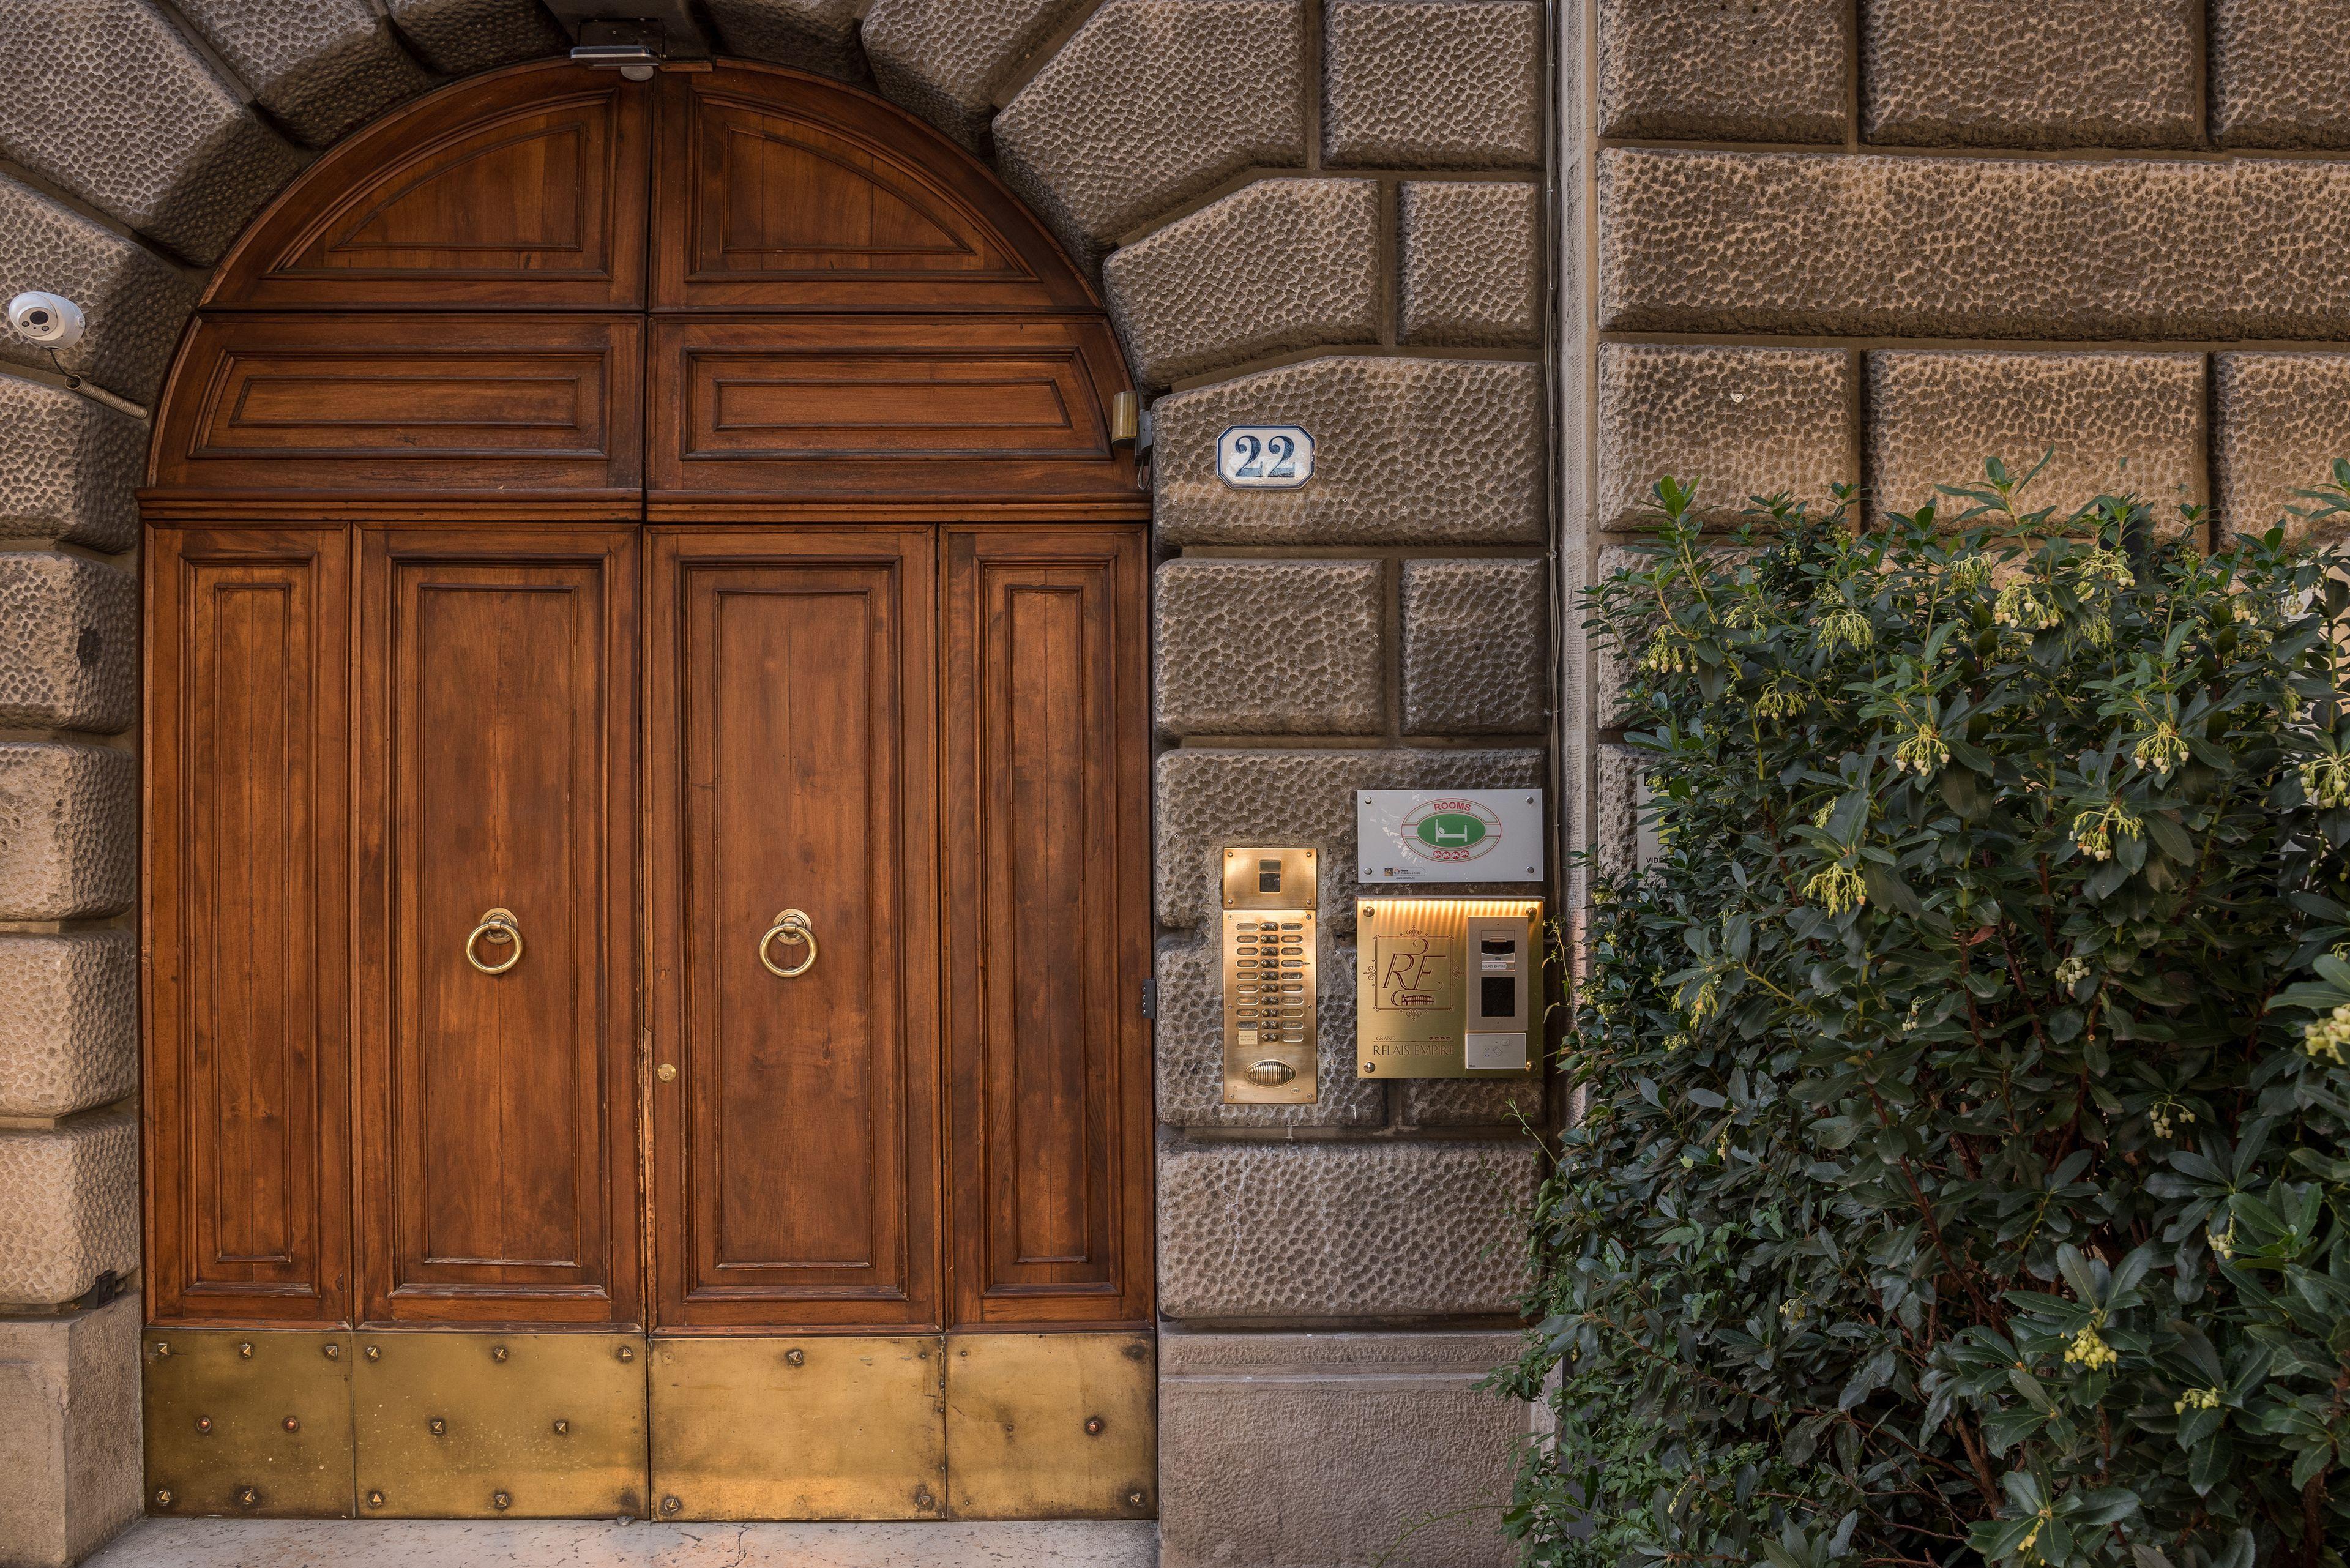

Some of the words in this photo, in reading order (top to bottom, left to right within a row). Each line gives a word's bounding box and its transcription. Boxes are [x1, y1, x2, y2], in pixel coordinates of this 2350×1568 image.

[1235, 435, 1296, 477] 22
[1434, 802, 1471, 811] ROOMS
[1373, 1045, 1410, 1056] RELAIS
[1414, 1045, 1455, 1056] EMPIRE
